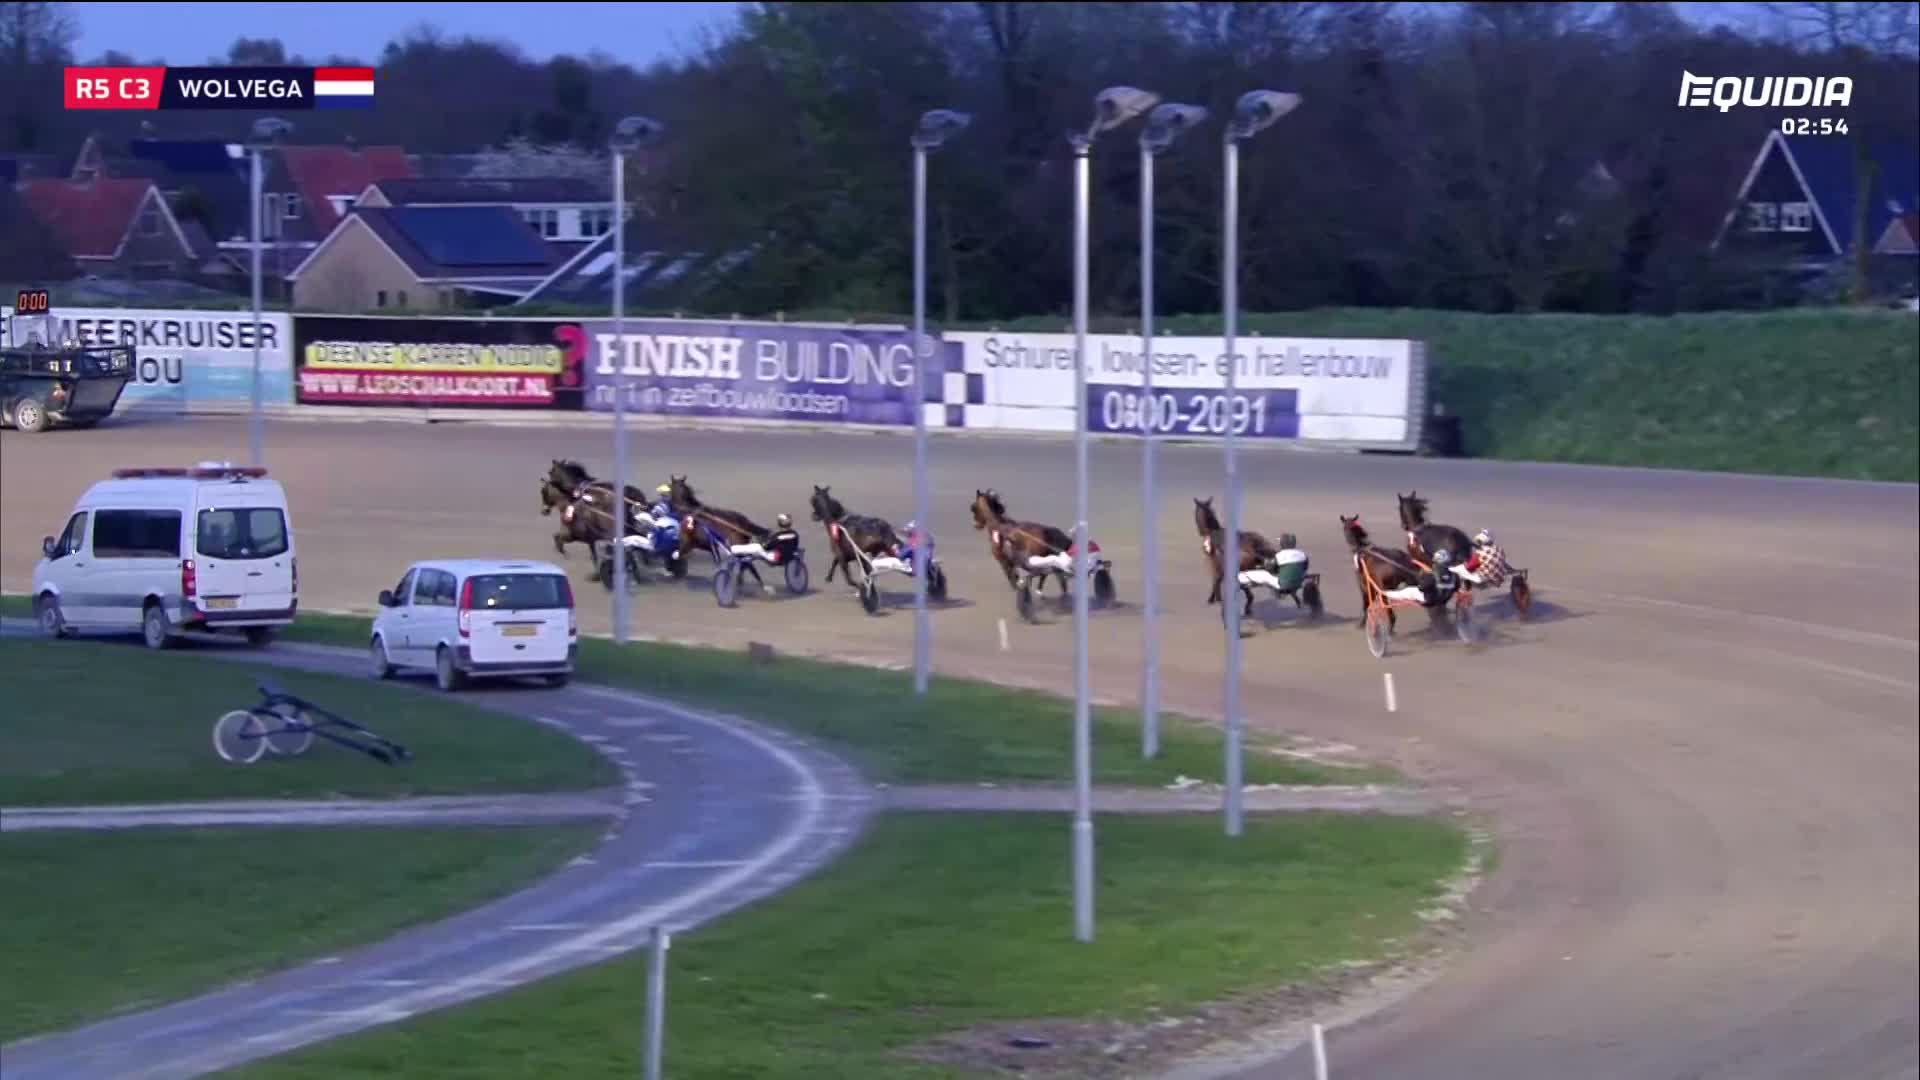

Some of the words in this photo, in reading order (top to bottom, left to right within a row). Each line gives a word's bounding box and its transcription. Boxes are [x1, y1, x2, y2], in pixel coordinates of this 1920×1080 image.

[315, 341, 394, 364] DEENSE
[595, 334, 743, 380] FINISH
[756, 340, 914, 387] BUILDING
[1215, 351, 1248, 377] en
[1255, 343, 1393, 379] hallenbouw
[1102, 391, 1267, 434] 0800-2091
